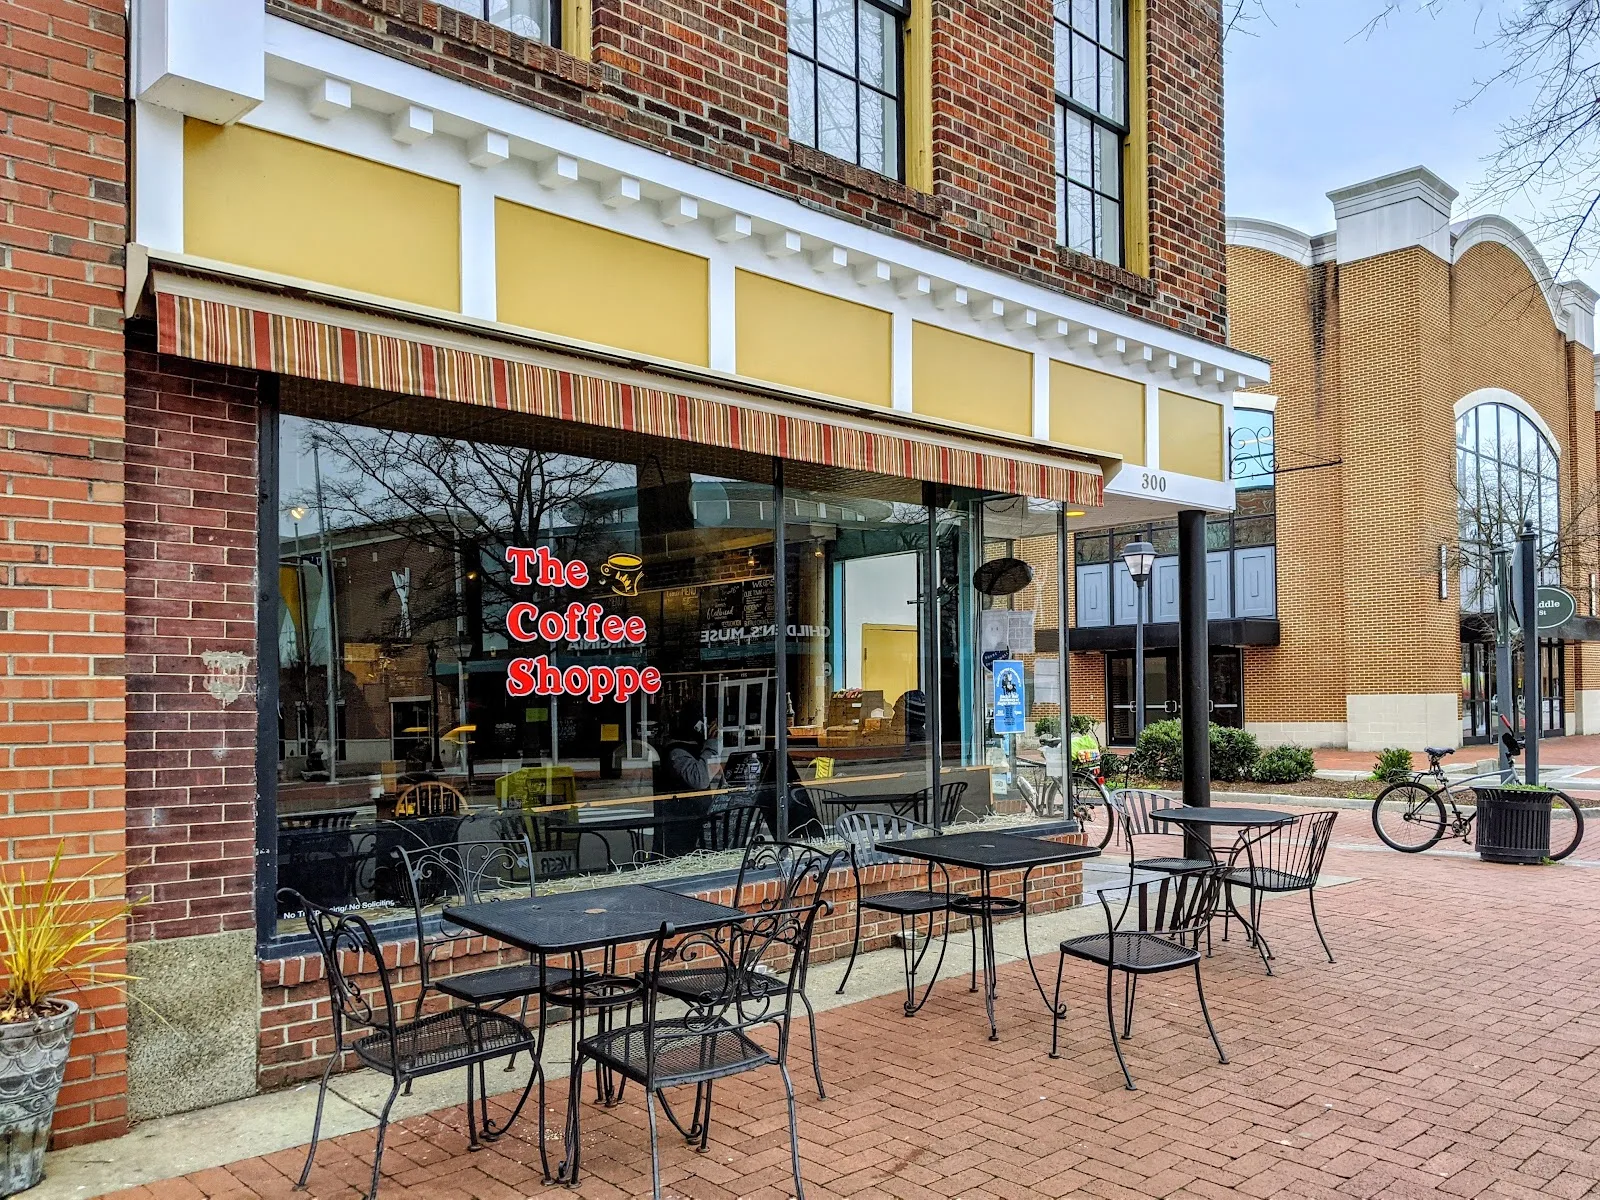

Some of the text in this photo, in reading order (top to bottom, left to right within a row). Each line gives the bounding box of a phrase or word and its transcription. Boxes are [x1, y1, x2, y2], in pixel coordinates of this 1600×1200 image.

[1141, 472, 1167, 493] 300
[505, 545, 590, 589] The
[1538, 600, 1560, 608] ddle
[506, 601, 646, 644] Coffee
[506, 654, 662, 704] Shoppe
[283, 910, 296, 920] No
[349, 903, 361, 911] No
[362, 899, 396, 910] Soliciting
